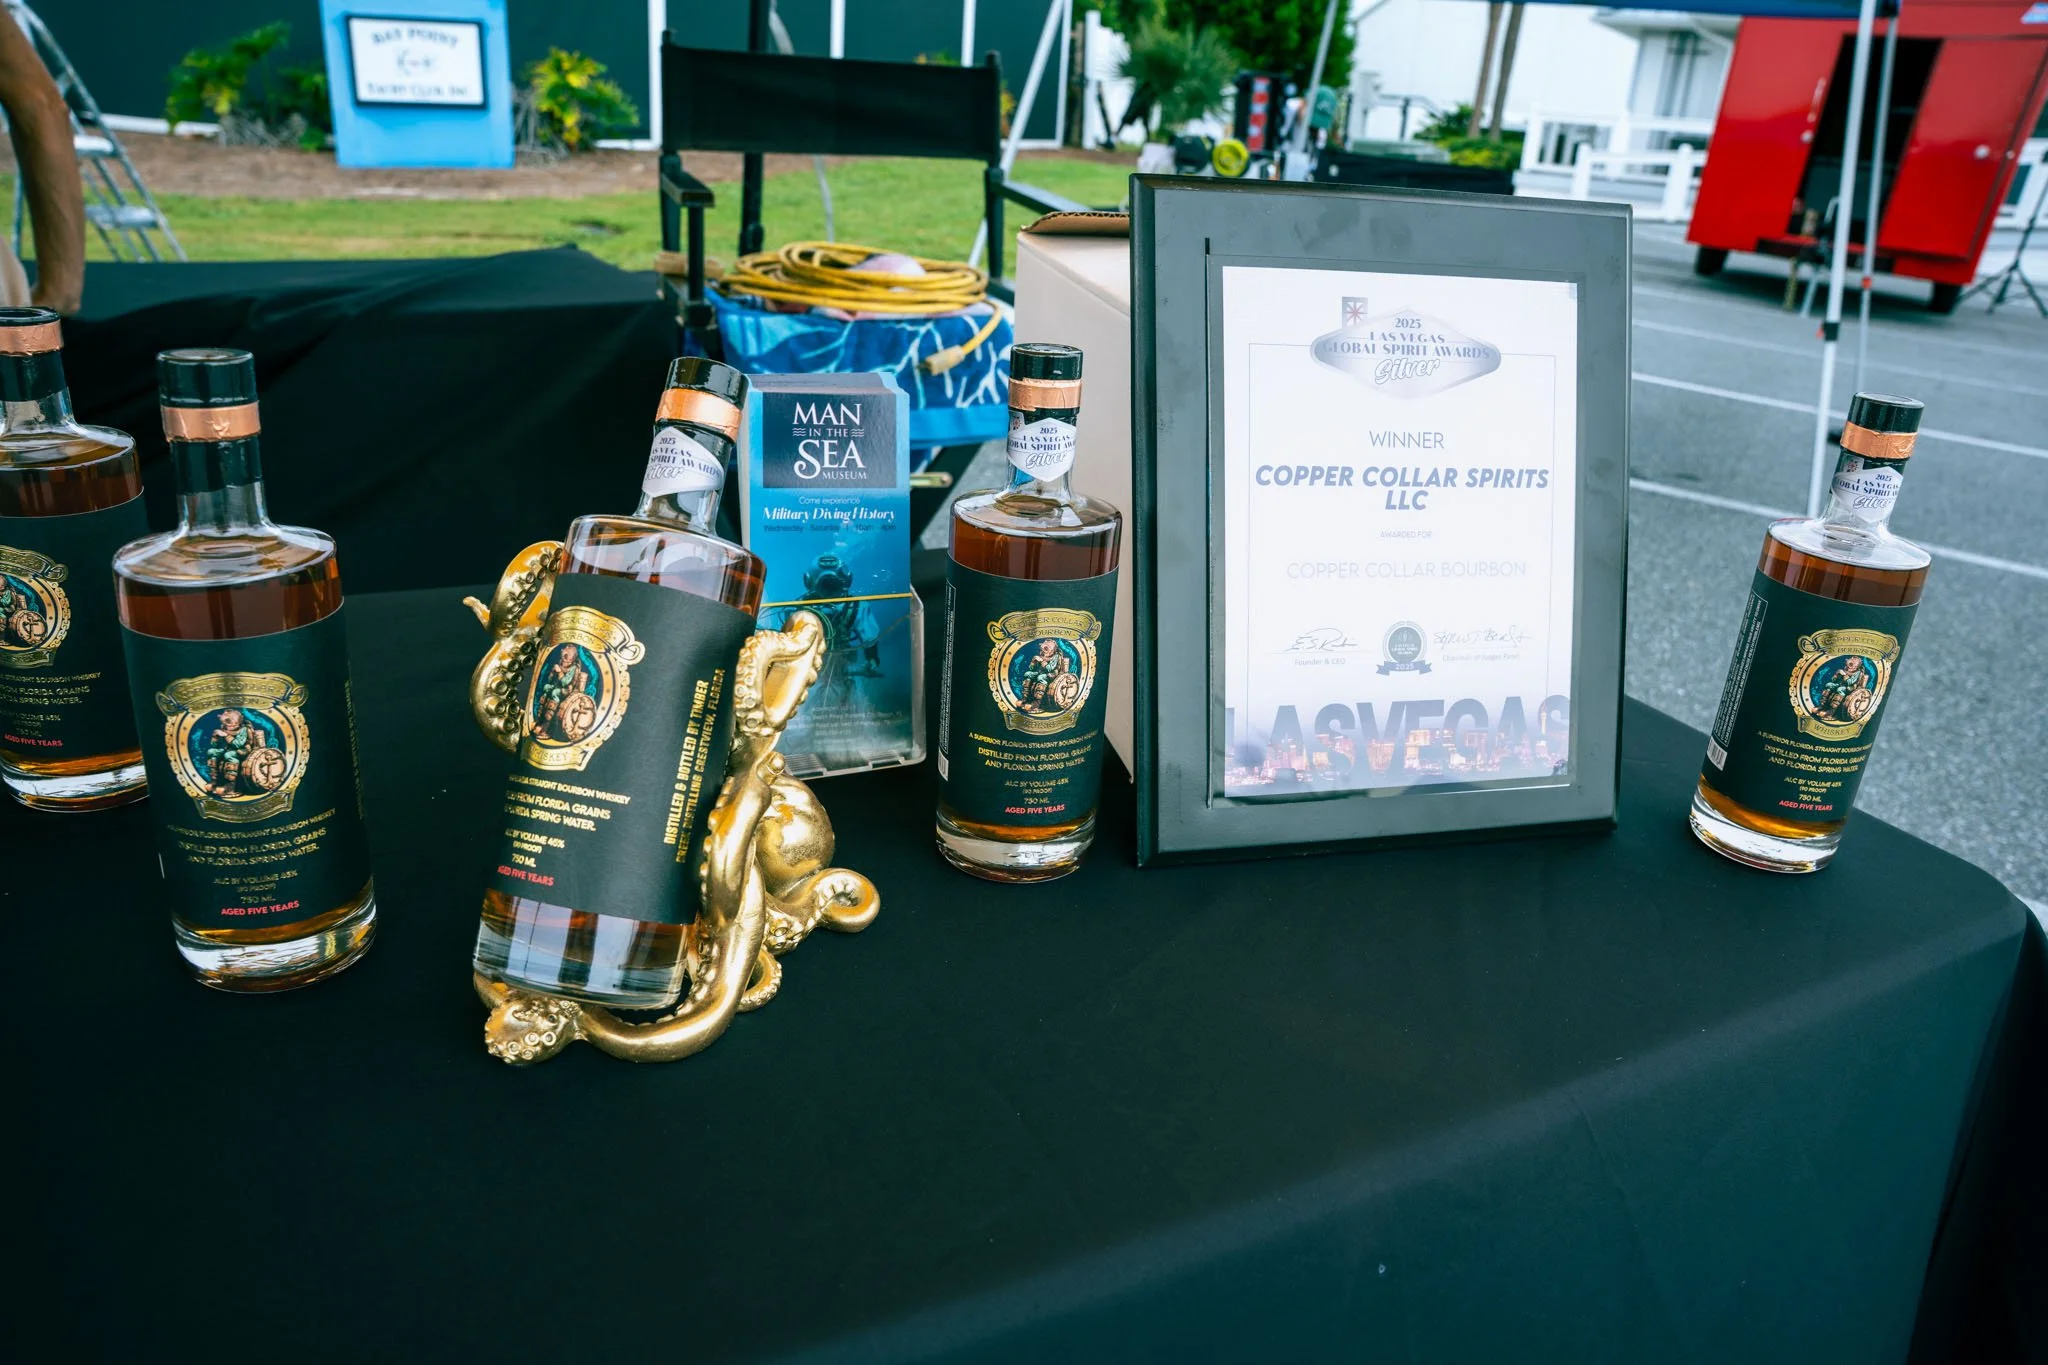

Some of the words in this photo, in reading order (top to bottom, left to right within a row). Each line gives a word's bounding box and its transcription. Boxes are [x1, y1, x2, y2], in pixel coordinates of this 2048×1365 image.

[1395, 317, 1422, 329] 2025
[1370, 331, 1397, 342] LAS
[1400, 333, 1446, 344] VEGAS
[1322, 341, 1376, 355] GLOBAL
[1383, 343, 1427, 357] SPIRIT
[1432, 345, 1490, 360] AWARDS
[1374, 357, 1441, 386] Silver
[792, 402, 861, 426] MAN
[808, 428, 821, 436] IN
[826, 428, 848, 437] THE
[1369, 430, 1445, 449] WINNER
[659, 437, 677, 445] 2025
[1031, 442, 1061, 451] SPIRIT
[794, 439, 867, 479] SEA
[1025, 452, 1066, 469] Silver
[822, 471, 867, 480] MUSEUM
[1255, 464, 1354, 487] COPPER
[1362, 466, 1458, 488] COLLAR
[1465, 467, 1550, 489] SPIRITS
[1875, 473, 1892, 481] 2025
[1863, 487, 1890, 496] SPIRIT
[799, 496, 821, 505] Come
[822, 497, 861, 506] experience
[1385, 489, 1430, 511] LLC
[763, 507, 809, 524] Military
[813, 507, 852, 524] Diving
[852, 507, 895, 523] History
[1380, 530, 1416, 538] AWARDED
[1417, 530, 1432, 538] FOR
[1286, 561, 1359, 579] COPPER
[1365, 561, 1436, 579] COLLAR
[1441, 560, 1526, 578] BOURBON
[1294, 658, 1322, 666] Founder
[1814, 722, 1850, 735] WHISKEY
[37, 739, 63, 747] YEARS
[1815, 745, 1841, 753] STRAIGHT
[978, 746, 1014, 760] DISTILLED
[1015, 754, 1038, 762] FROM
[1040, 752, 1070, 762] FLORIDA
[1764, 744, 1799, 759] DISTILLED
[1800, 754, 1821, 763] FROM
[1822, 756, 1848, 765] FLORIDA
[663, 792, 685, 845] DISTILLED
[676, 736, 697, 781] BOTTLED
[690, 679, 709, 719] TIMBER
[985, 759, 1002, 768] AND
[1003, 763, 1037, 772] FLORIDA
[1037, 761, 1065, 771] SPRING
[1769, 755, 1785, 765] AND
[1786, 760, 1817, 772] FLORIDA
[1818, 765, 1842, 774] SPRING
[1029, 779, 1057, 788] VOLUME
[1807, 780, 1831, 788] VOLUME
[557, 782, 596, 798] BOURBON
[596, 790, 631, 805] WHISKEY
[1799, 794, 1812, 802] 750
[535, 795, 571, 812] FLORIDA
[571, 803, 611, 820] GRAINS
[1004, 806, 1026, 814] AGED
[1044, 803, 1065, 813] YEARS
[1779, 800, 1798, 809] AGED
[530, 808, 562, 824] SPRING
[293, 827, 327, 845] GRAINS
[520, 831, 549, 845] VOLUME
[527, 872, 554, 887] YEARS
[221, 908, 246, 916] AGED
[247, 906, 268, 915] FIVE
[269, 900, 300, 913] YEARS
